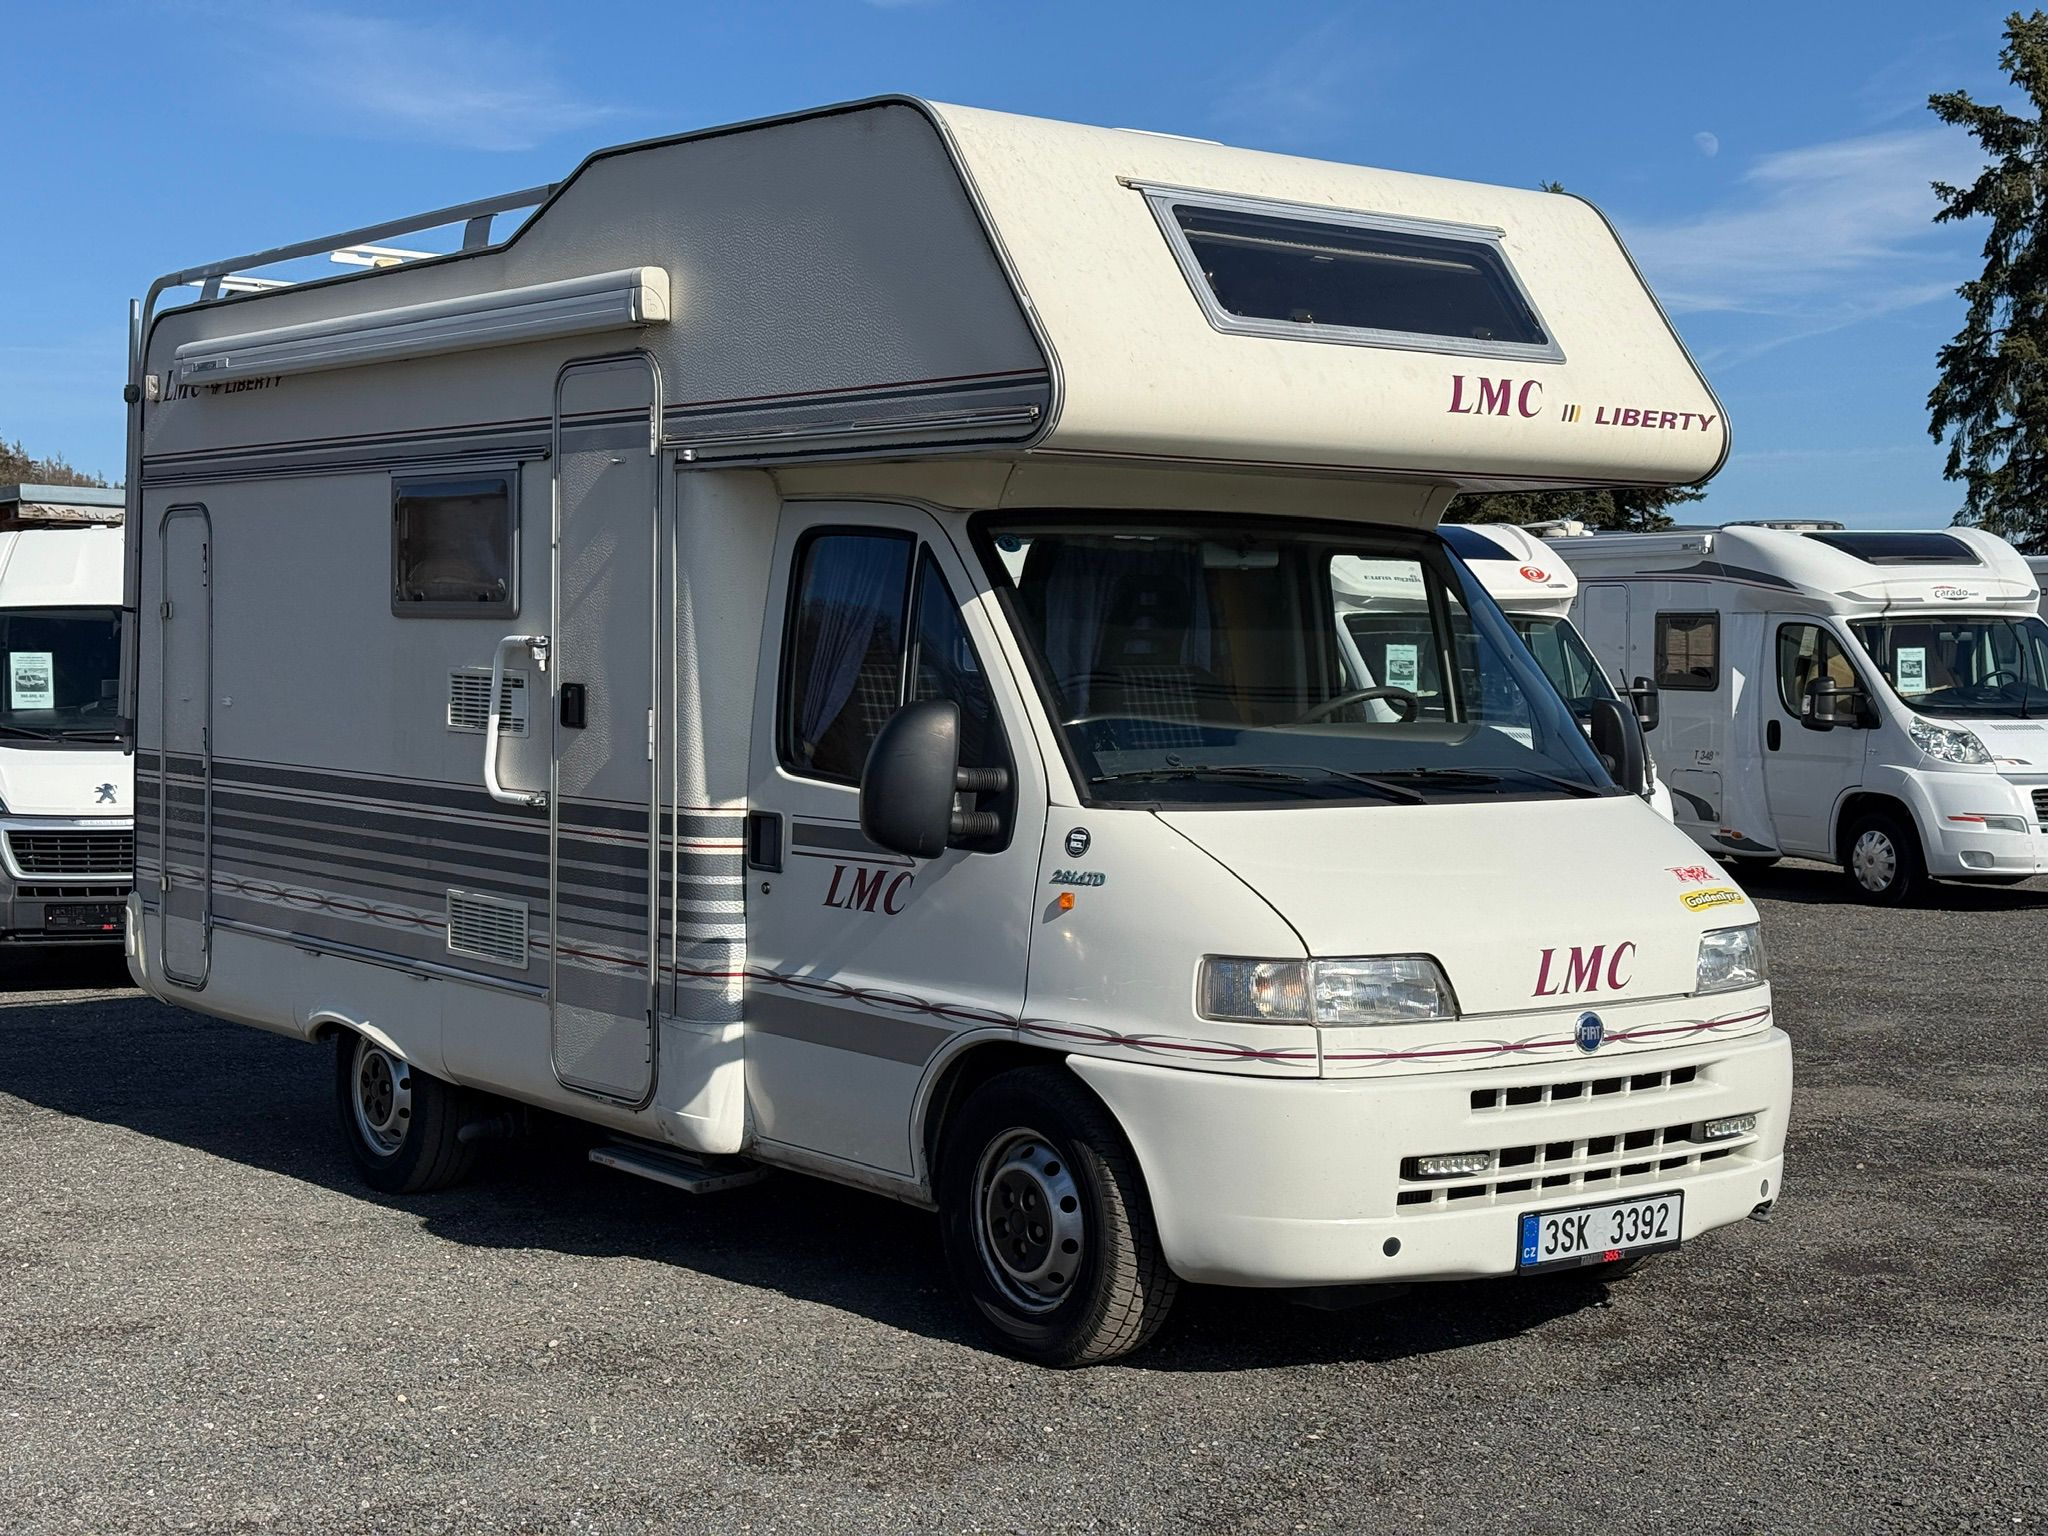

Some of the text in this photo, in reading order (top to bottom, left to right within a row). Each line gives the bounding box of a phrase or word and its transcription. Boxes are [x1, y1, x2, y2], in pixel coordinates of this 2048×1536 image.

[1447, 374, 1716, 432] LMC LIBERTY
[1934, 588, 1968, 599] carado
[822, 865, 916, 916] LMC
[1531, 941, 1637, 997] LMC
[1581, 1025, 1601, 1041] FIAT
[1523, 1246, 1537, 1259] CZ
[1544, 1202, 1669, 1255] 3SK 3392
